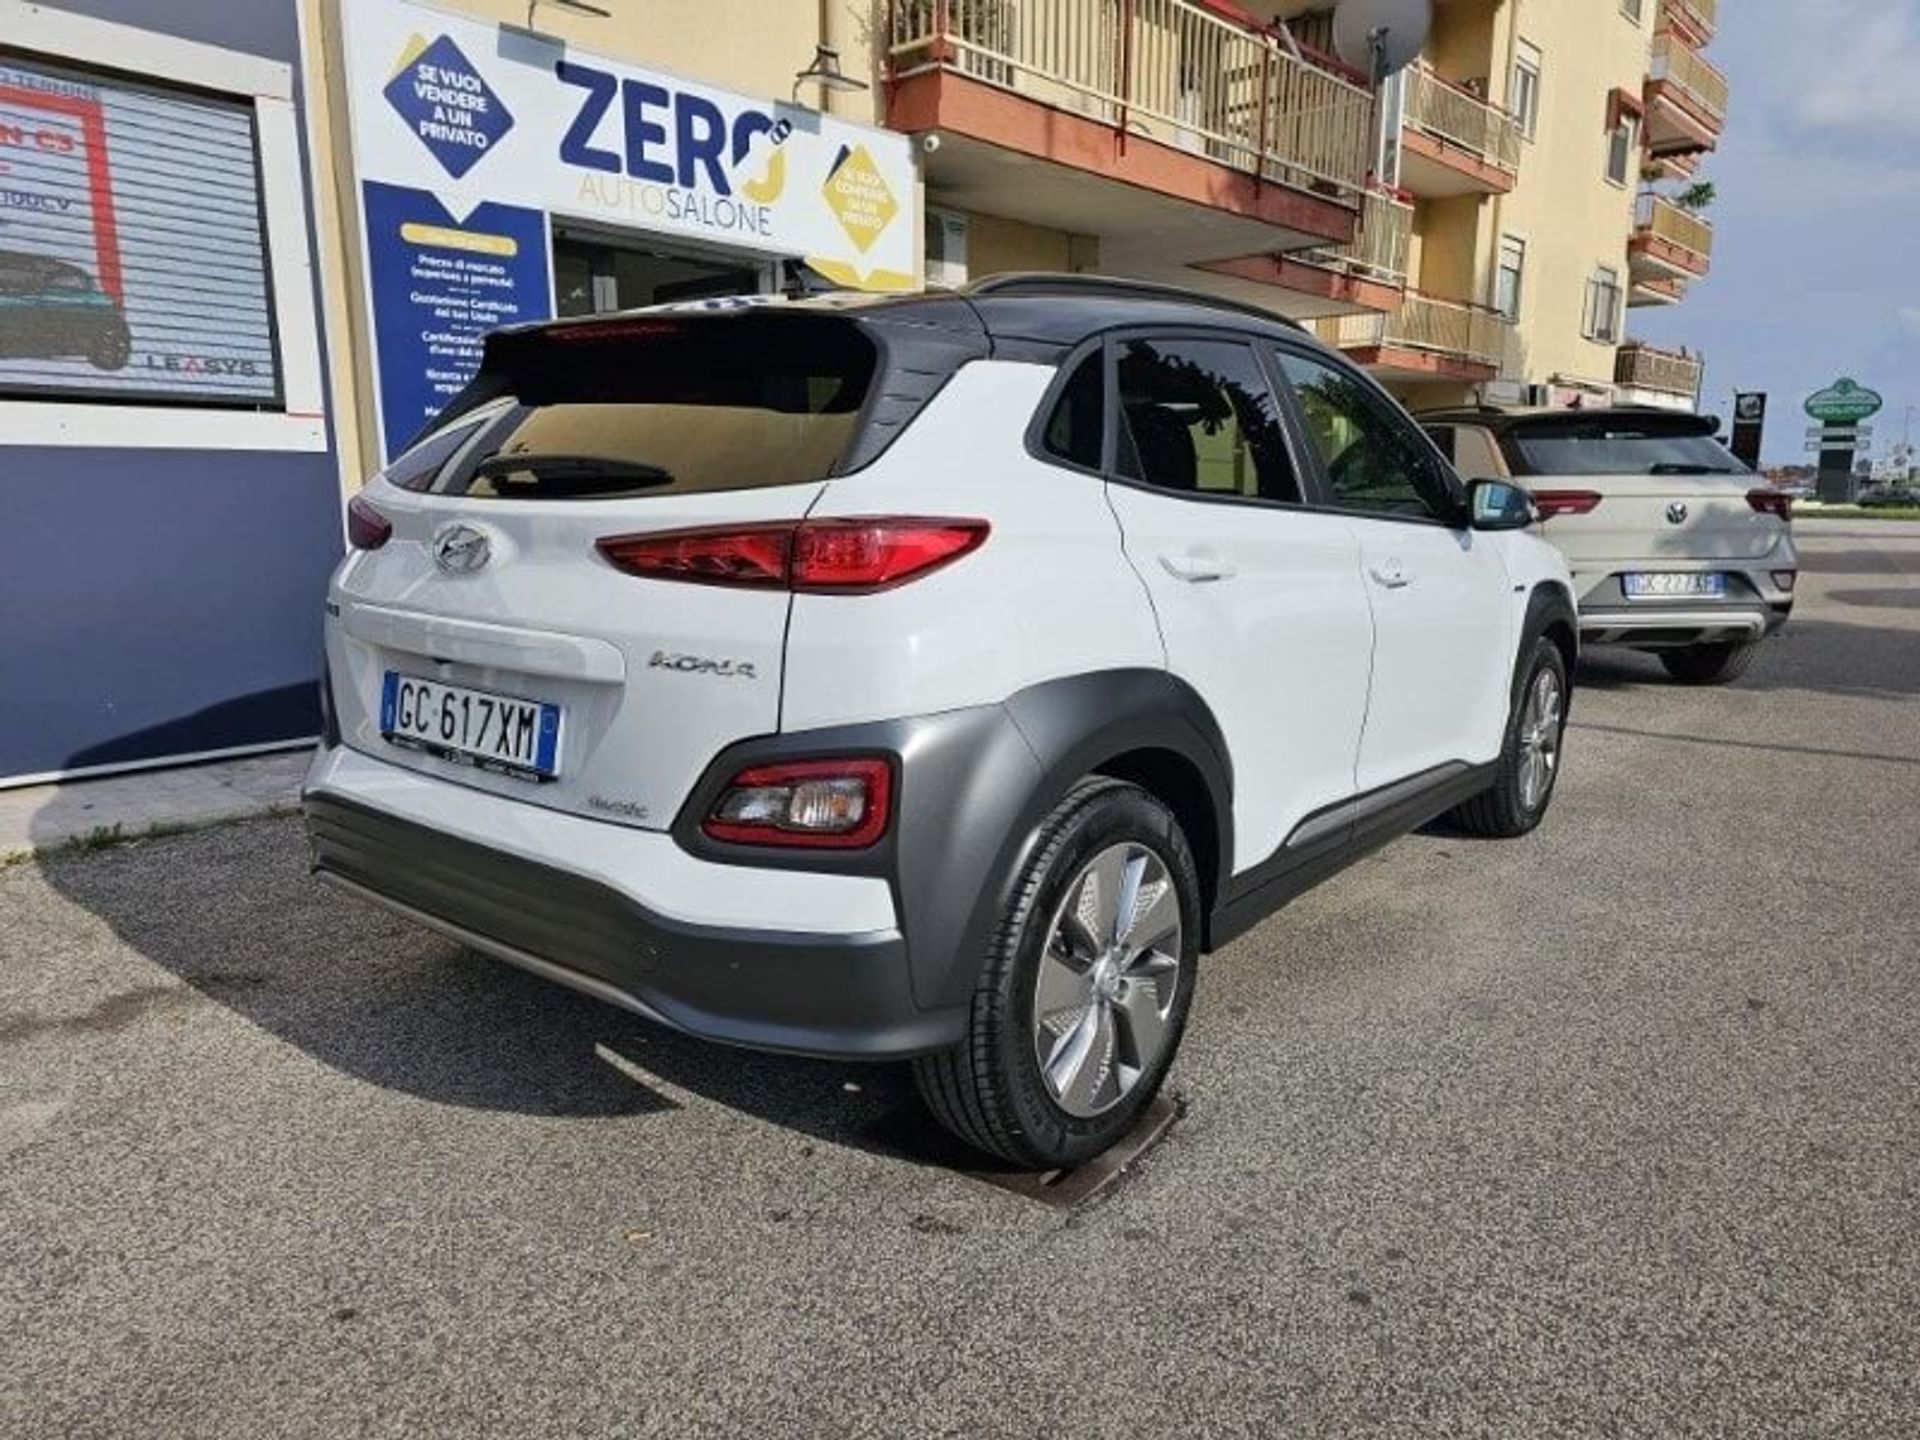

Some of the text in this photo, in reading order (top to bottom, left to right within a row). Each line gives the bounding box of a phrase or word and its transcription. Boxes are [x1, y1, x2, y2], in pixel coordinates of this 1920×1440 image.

[417, 63, 482, 93] SE VUOI
[414, 80, 488, 113] VENDERE
[434, 105, 472, 127] A UN
[555, 60, 788, 203] ZERO
[420, 120, 487, 149] PRIVATO
[577, 173, 772, 237] AUTOSALONE
[146, 355, 257, 378] LEASYS
[399, 682, 431, 733] GC
[440, 691, 536, 761] 617XM
